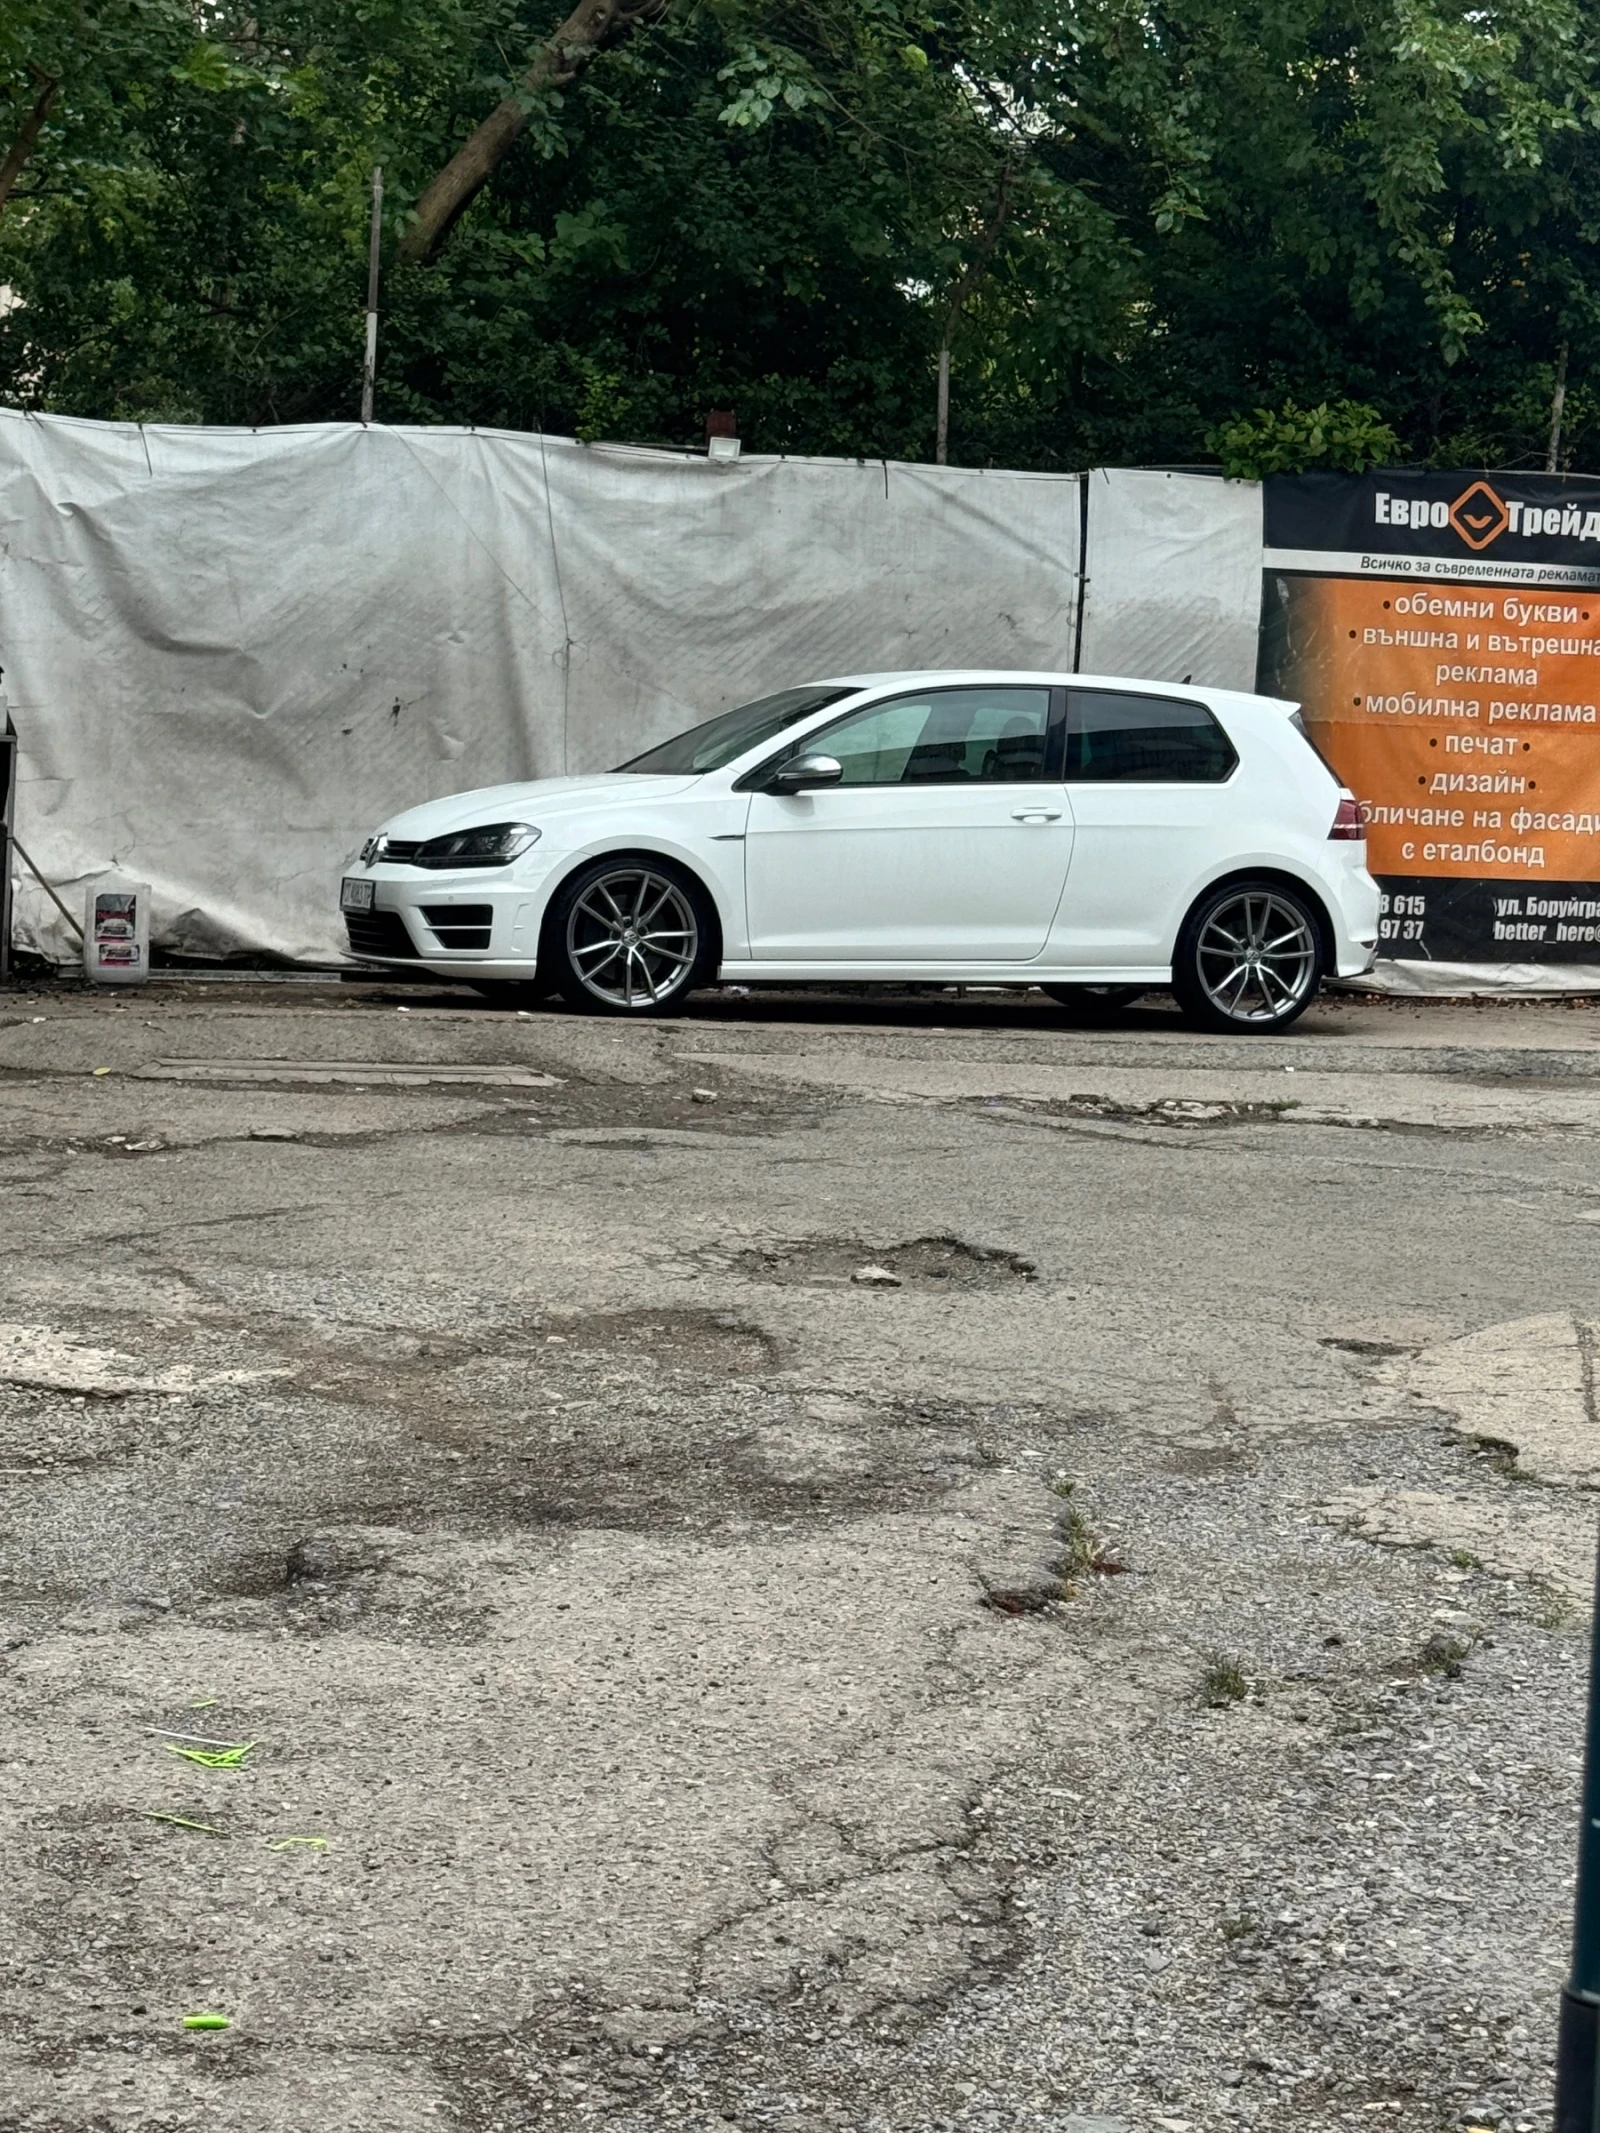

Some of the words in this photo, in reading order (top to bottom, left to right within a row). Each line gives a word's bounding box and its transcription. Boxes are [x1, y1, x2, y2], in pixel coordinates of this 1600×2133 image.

[1375, 492, 1449, 529] Евро
[1505, 501, 1600, 541] Трейд
[1361, 556, 1411, 572] Всичко
[1415, 560, 1431, 573] за
[1435, 562, 1535, 579] съвременната
[1394, 592, 1494, 618] обемни
[1503, 597, 1578, 626] букви
[1363, 627, 1458, 649] външна
[1467, 632, 1479, 650] и
[1436, 664, 1538, 686] реклама
[1366, 691, 1480, 718] мобилна
[1488, 701, 1597, 724] реклама
[1445, 735, 1518, 755] печат
[1429, 770, 1526, 794] дизайн
[1357, 800, 1464, 826] бличане
[1473, 808, 1501, 829] на
[1401, 841, 1415, 860] с
[1423, 839, 1545, 868] еталбонд
[1393, 895, 1425, 915] 615
[1497, 898, 1522, 916] ул.
